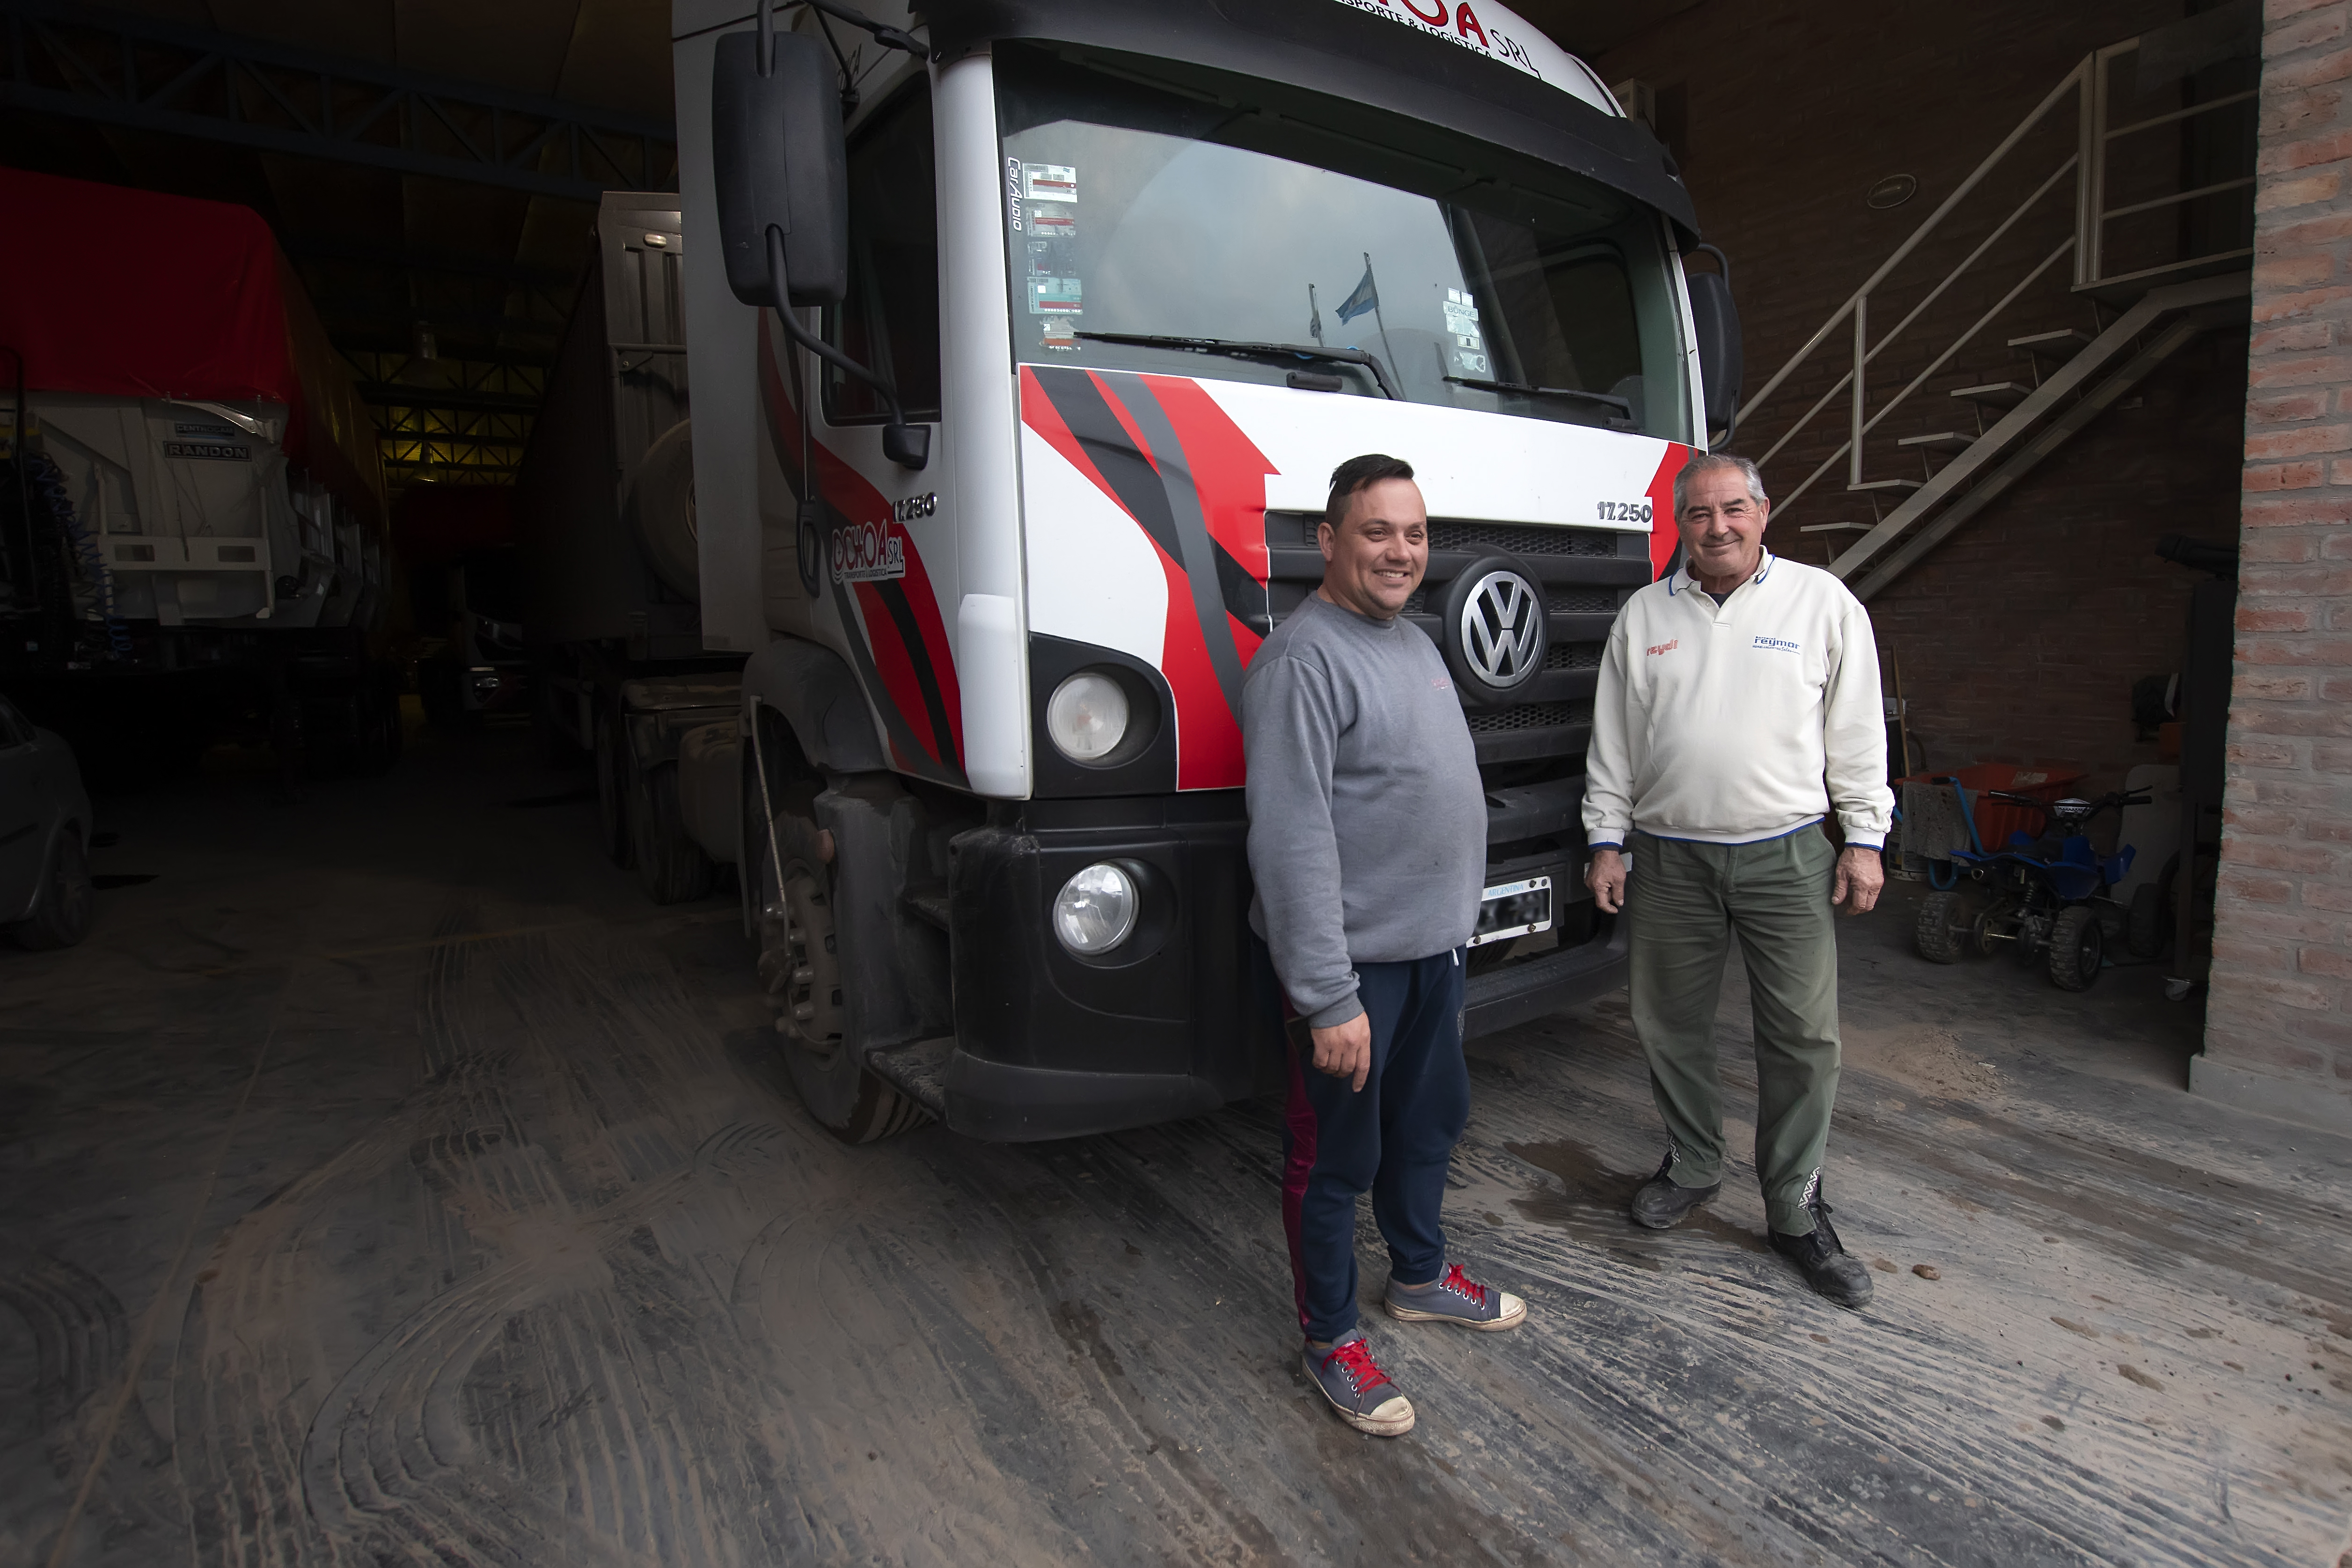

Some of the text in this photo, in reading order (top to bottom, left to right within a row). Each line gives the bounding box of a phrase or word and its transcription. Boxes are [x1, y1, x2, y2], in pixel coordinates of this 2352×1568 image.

[1408, 18, 1418, 28] &
[1490, 29, 1540, 74] SRL
[1448, 305, 1474, 318] BUNGE
[169, 445, 247, 458] RANDON
[1597, 501, 1653, 523] 17.250
[833, 522, 903, 571] OCHOA SRL
